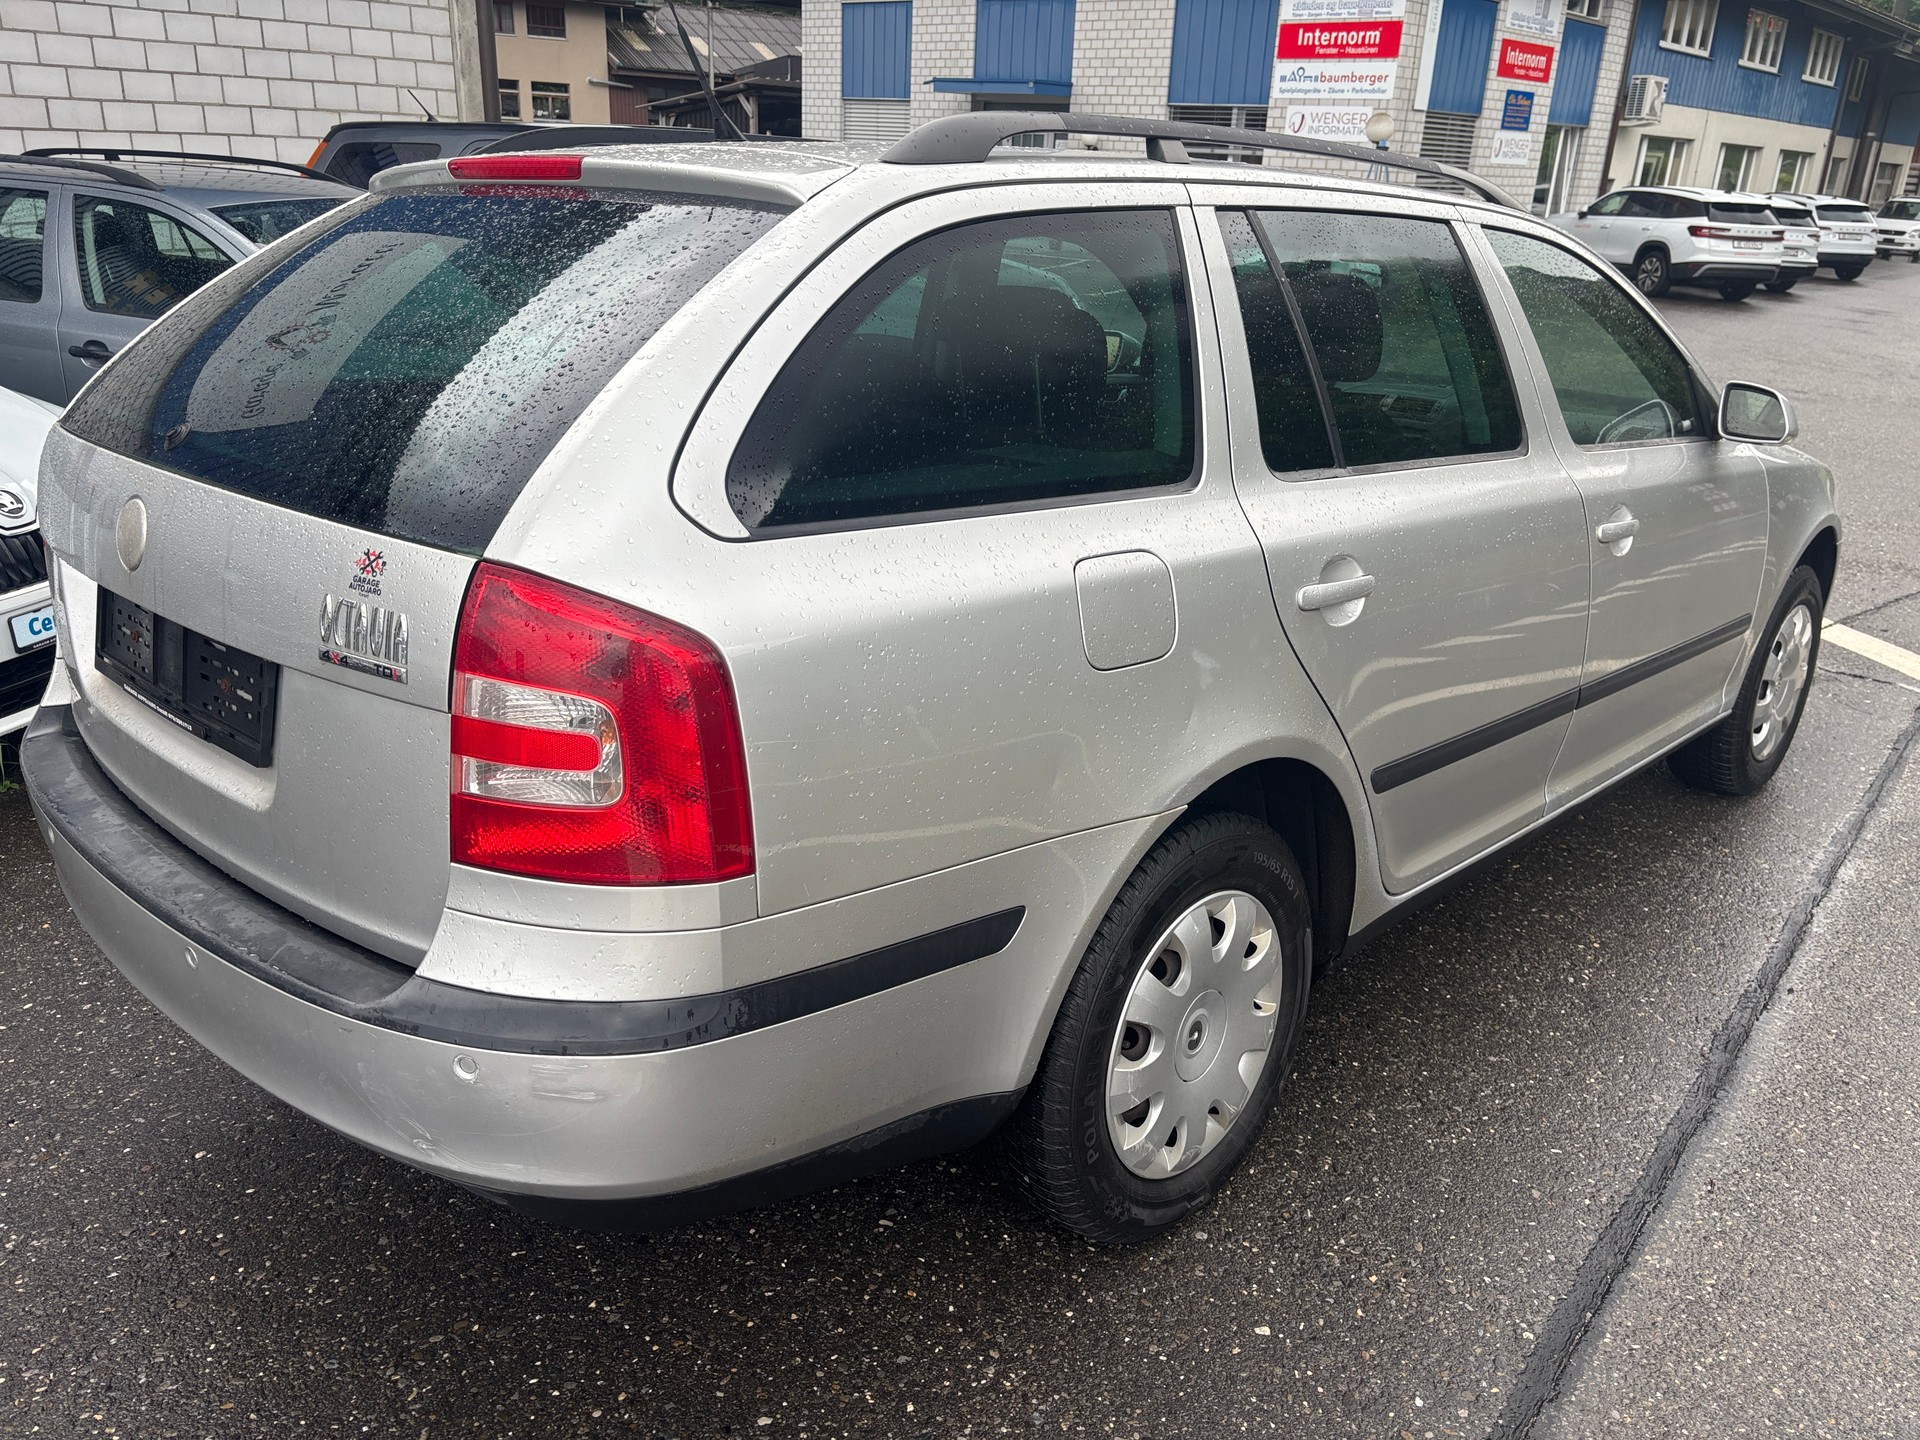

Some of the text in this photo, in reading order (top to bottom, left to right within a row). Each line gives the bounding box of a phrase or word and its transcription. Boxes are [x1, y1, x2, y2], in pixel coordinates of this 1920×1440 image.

[1297, 27, 1381, 46] Internorm
[1315, 46, 1379, 54] Fenster Haustüren
[1506, 46, 1547, 70] Internorm
[1320, 71, 1389, 86] baumberger
[1279, 86, 1321, 95] Spielplatzgeräte
[1310, 111, 1369, 125] WENGER
[1307, 125, 1366, 136] INFORMATIK
[348, 582, 382, 597] AUTOJARO
[352, 575, 381, 589] GARAGE
[29, 615, 56, 635] Ce
[319, 593, 409, 666] OCTAVIA
[1253, 851, 1281, 874] 195/65
[1280, 867, 1296, 891] R15
